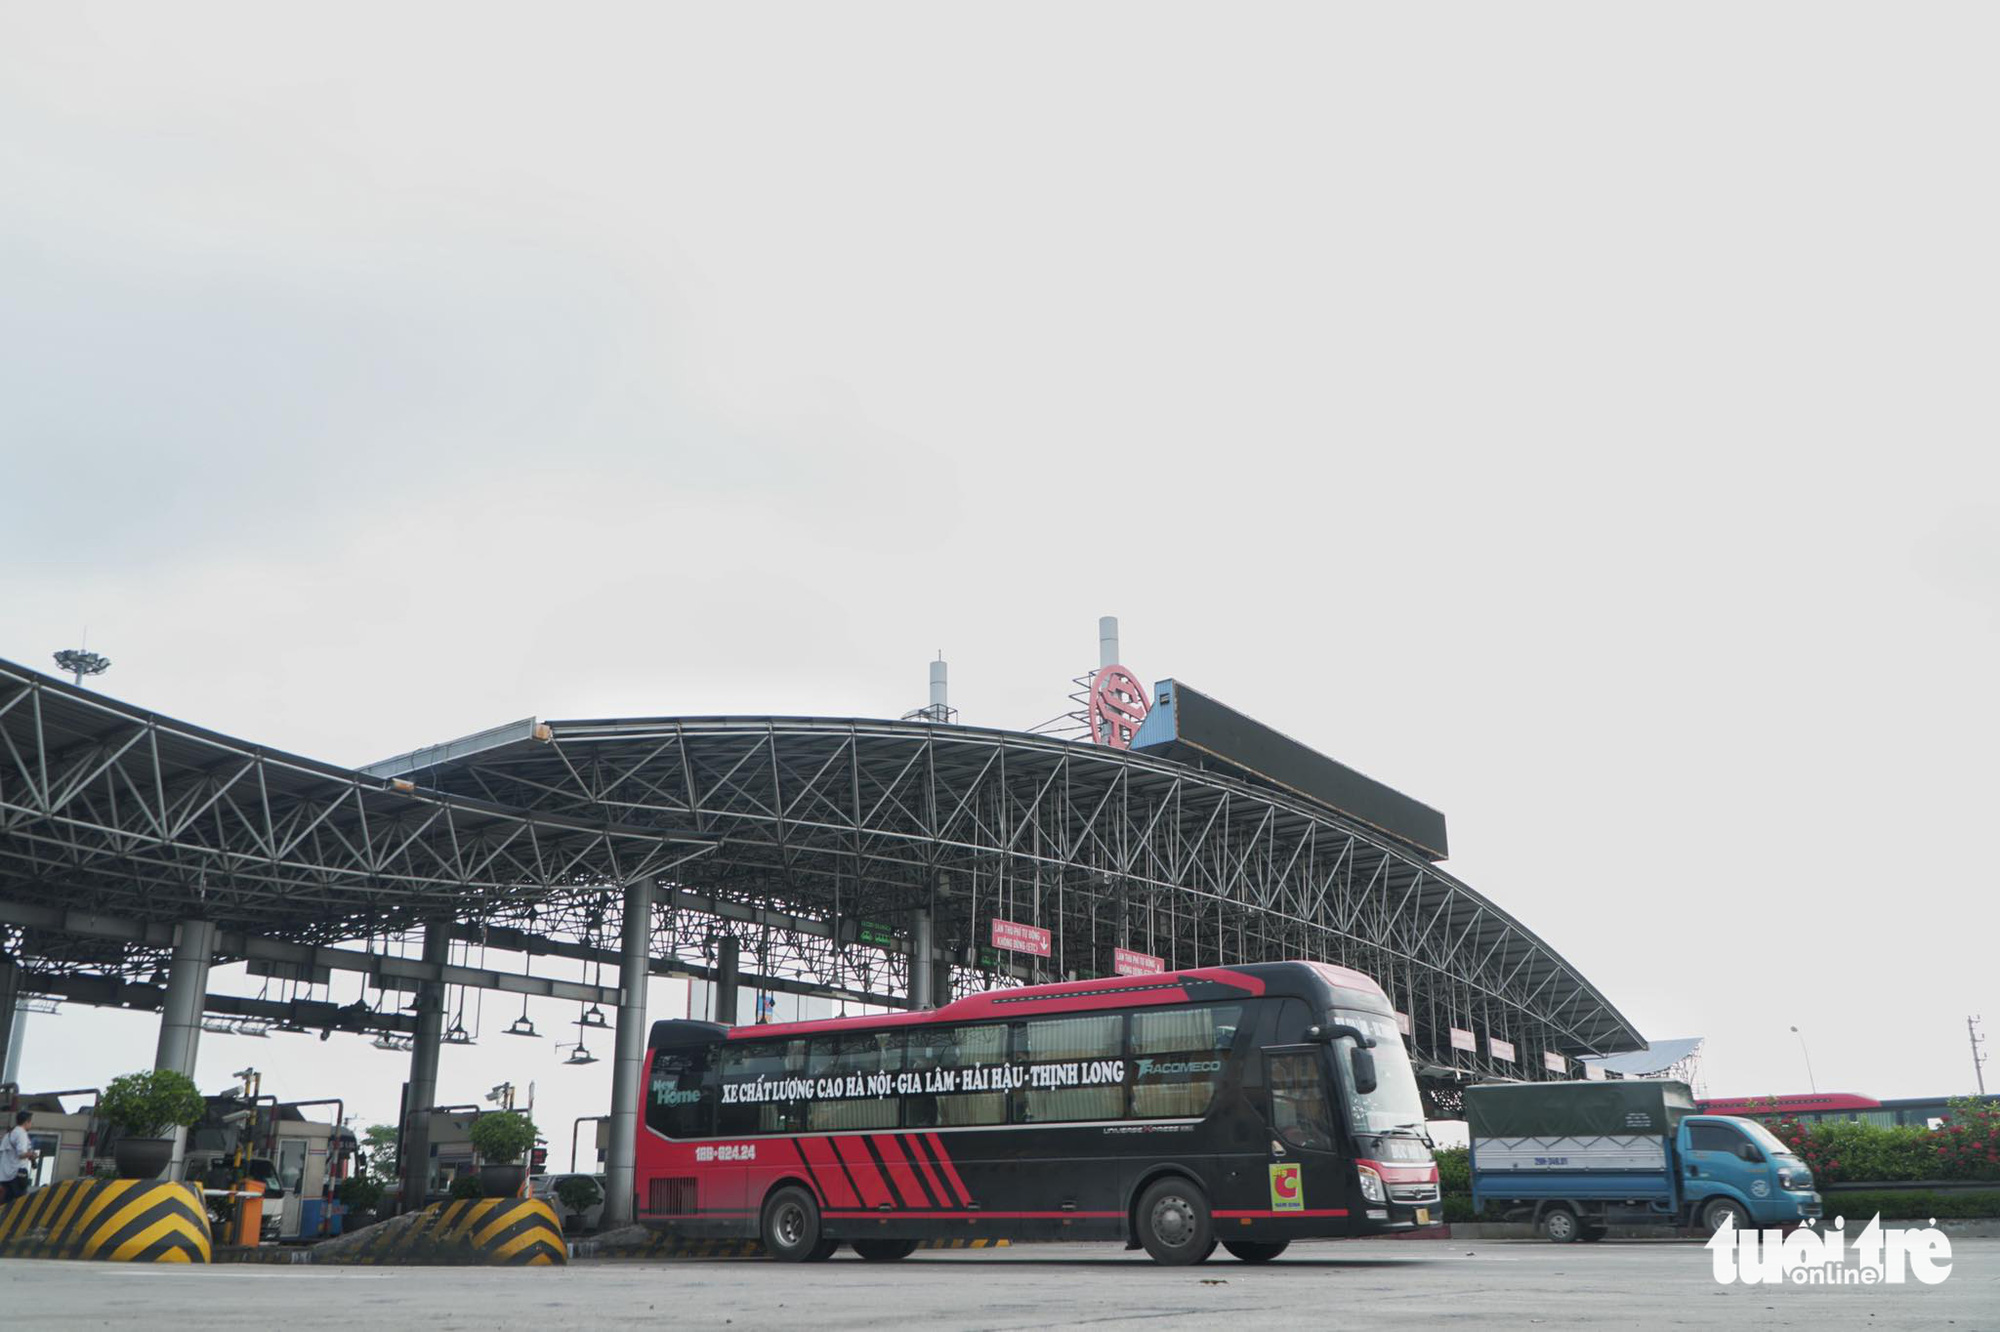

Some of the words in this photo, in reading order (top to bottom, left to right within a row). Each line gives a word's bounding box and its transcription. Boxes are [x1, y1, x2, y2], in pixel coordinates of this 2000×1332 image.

[1134, 1059, 1221, 1079] TRACOMECO
[653, 1080, 676, 1092] New
[721, 1084, 738, 1103] XE
[739, 1074, 772, 1102] CHẤT
[771, 1076, 815, 1105] LƯỢNG
[817, 1077, 844, 1098] CAO
[845, 1070, 866, 1097] HÀ
[897, 1073, 922, 1094] GIA
[1081, 1060, 1125, 1084] LONG
[657, 1089, 701, 1106] Home
